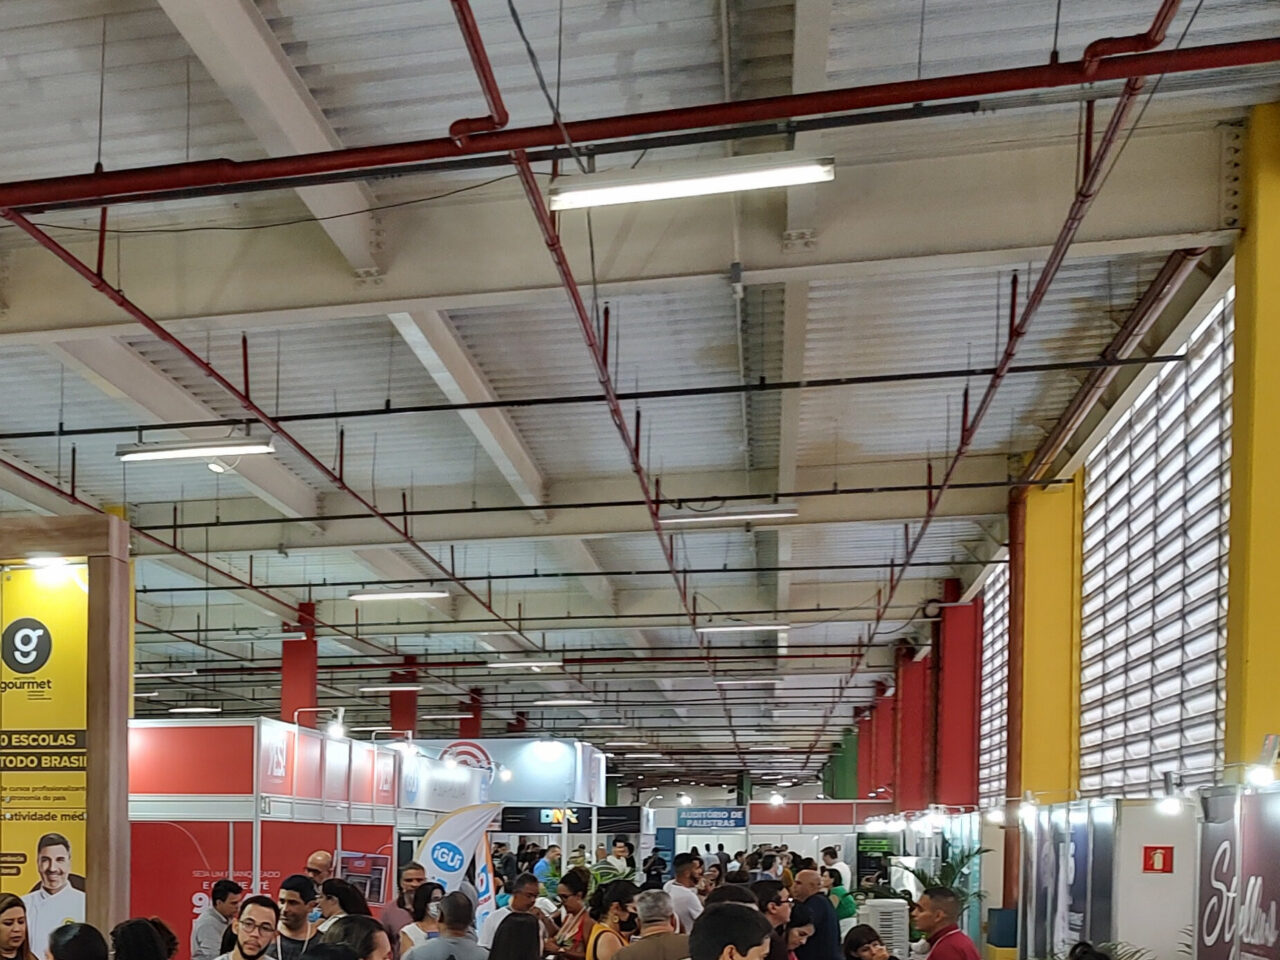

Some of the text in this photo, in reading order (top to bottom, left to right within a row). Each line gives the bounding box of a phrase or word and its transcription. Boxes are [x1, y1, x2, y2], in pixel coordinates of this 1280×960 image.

[0, 679, 52, 692] gourmet
[11, 734, 76, 746] ESCOLAS
[32, 785, 87, 794] profissionalizant
[60, 810, 88, 821] méd
[680, 810, 743, 819] AUDITÓRIO DE
[686, 819, 736, 827] PALESTRAS
